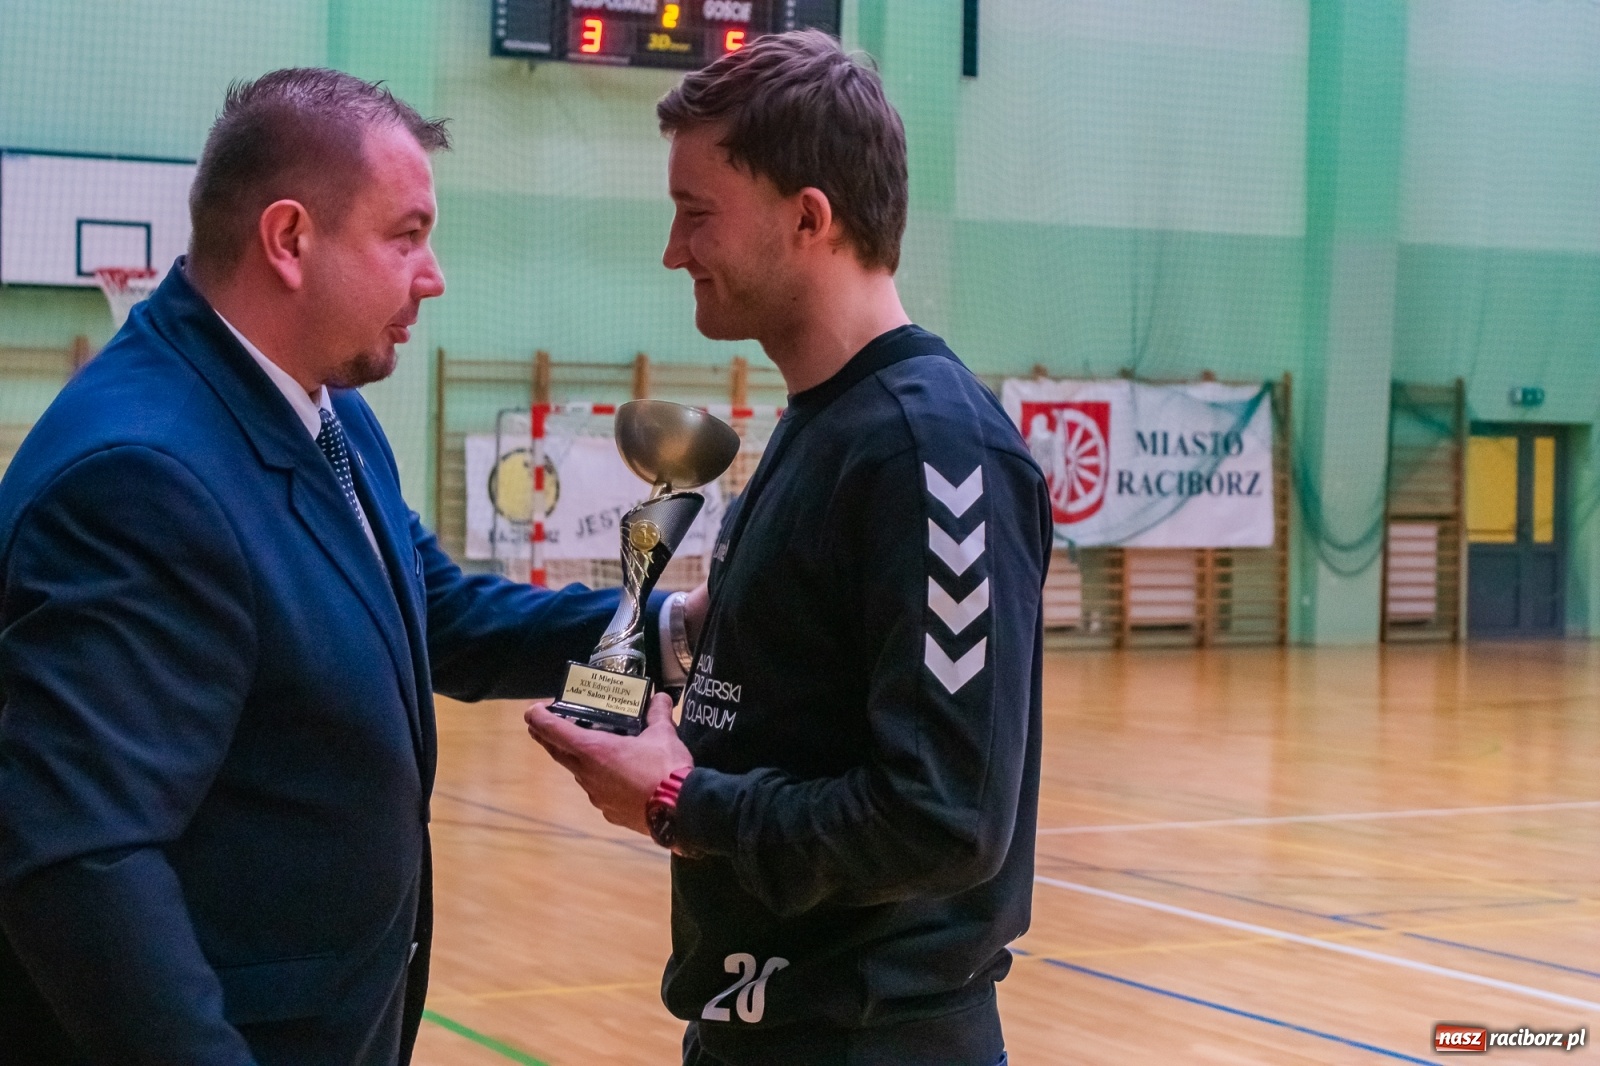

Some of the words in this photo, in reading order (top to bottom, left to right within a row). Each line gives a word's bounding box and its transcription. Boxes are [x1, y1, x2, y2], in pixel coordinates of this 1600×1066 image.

[662, 4, 680, 28] 2
[581, 19, 603, 53] 3
[1136, 430, 1243, 457] MIASTO
[580, 679, 591, 688] XIX
[592, 682, 611, 693] Edycji
[599, 674, 624, 686] Miejsce
[587, 690, 606, 700] Salon
[607, 694, 640, 707] Fryzjerski
